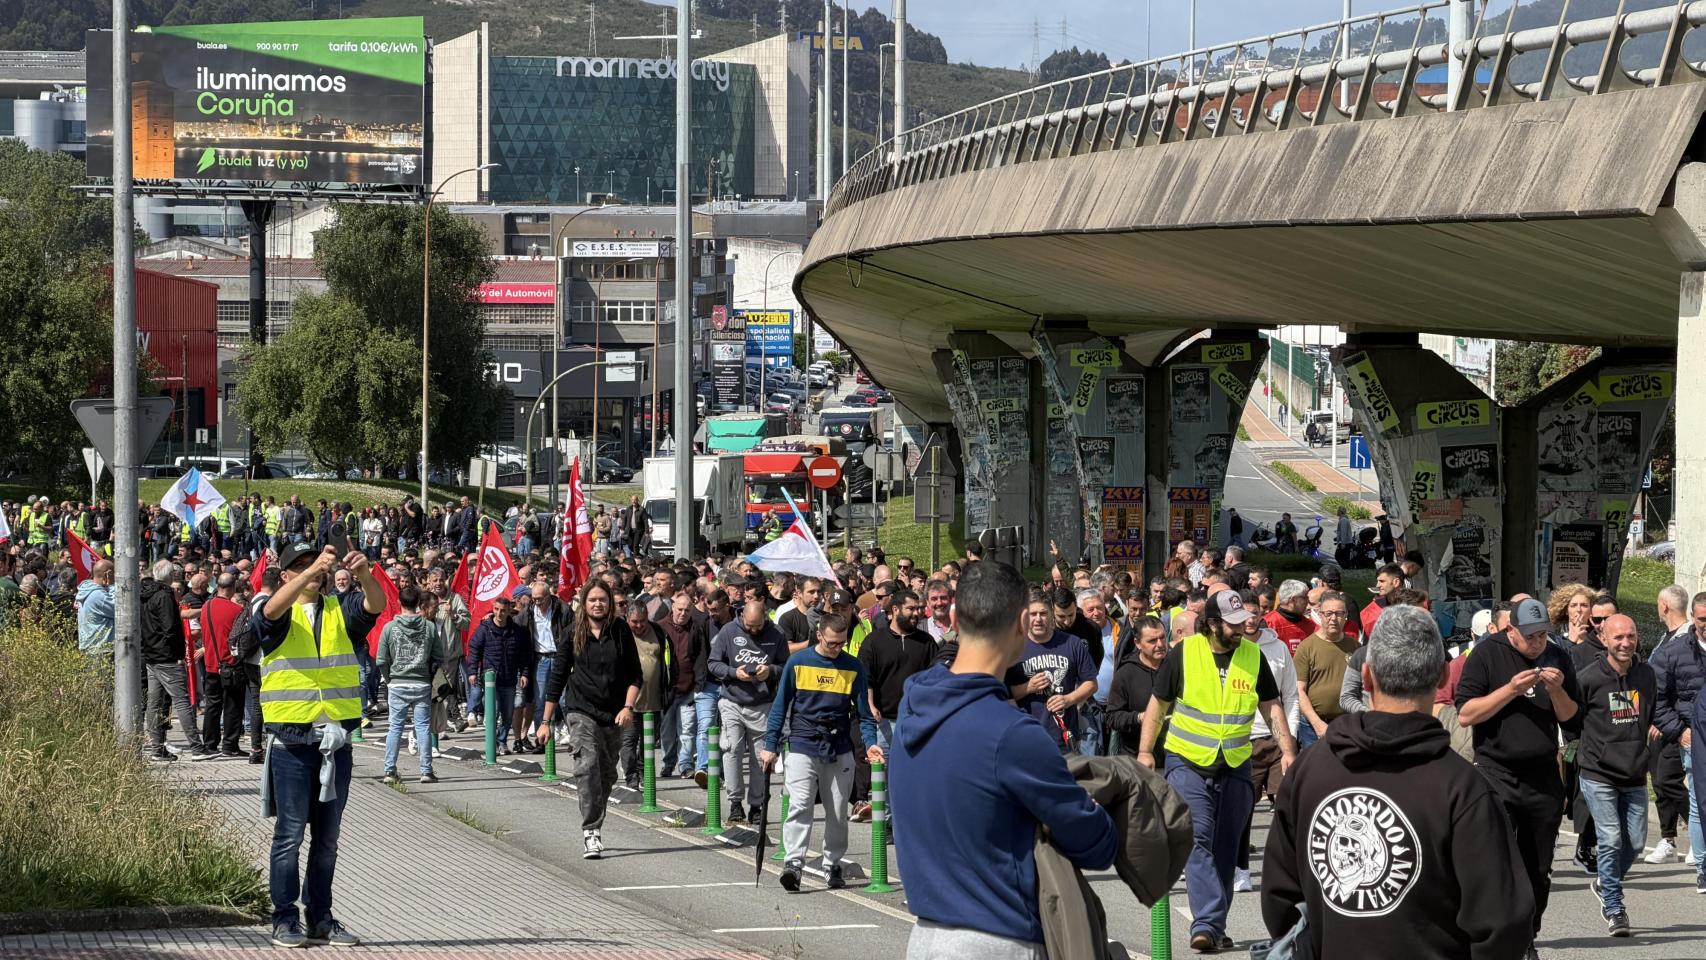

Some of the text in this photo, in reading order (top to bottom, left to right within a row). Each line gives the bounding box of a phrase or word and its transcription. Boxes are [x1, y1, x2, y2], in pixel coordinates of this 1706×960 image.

[291, 43, 299, 51] 17
[328, 42, 418, 54] tarifa 0,10€/kWh
[813, 35, 864, 50] KEA
[196, 67, 347, 93] iluminamos
[690, 59, 730, 92] city
[196, 91, 294, 116] Coruña
[257, 156, 275, 167] luz
[276, 156, 288, 170] (y
[290, 156, 308, 170] ya)
[488, 288, 503, 298] del
[505, 288, 553, 298] Automóvil
[778, 356, 788, 366] P
[734, 648, 768, 665] Ford
[1022, 654, 1069, 674] WRANGLER
[816, 674, 834, 685] VANS
[1311, 794, 1413, 910] MOTEIROS DO METAL
